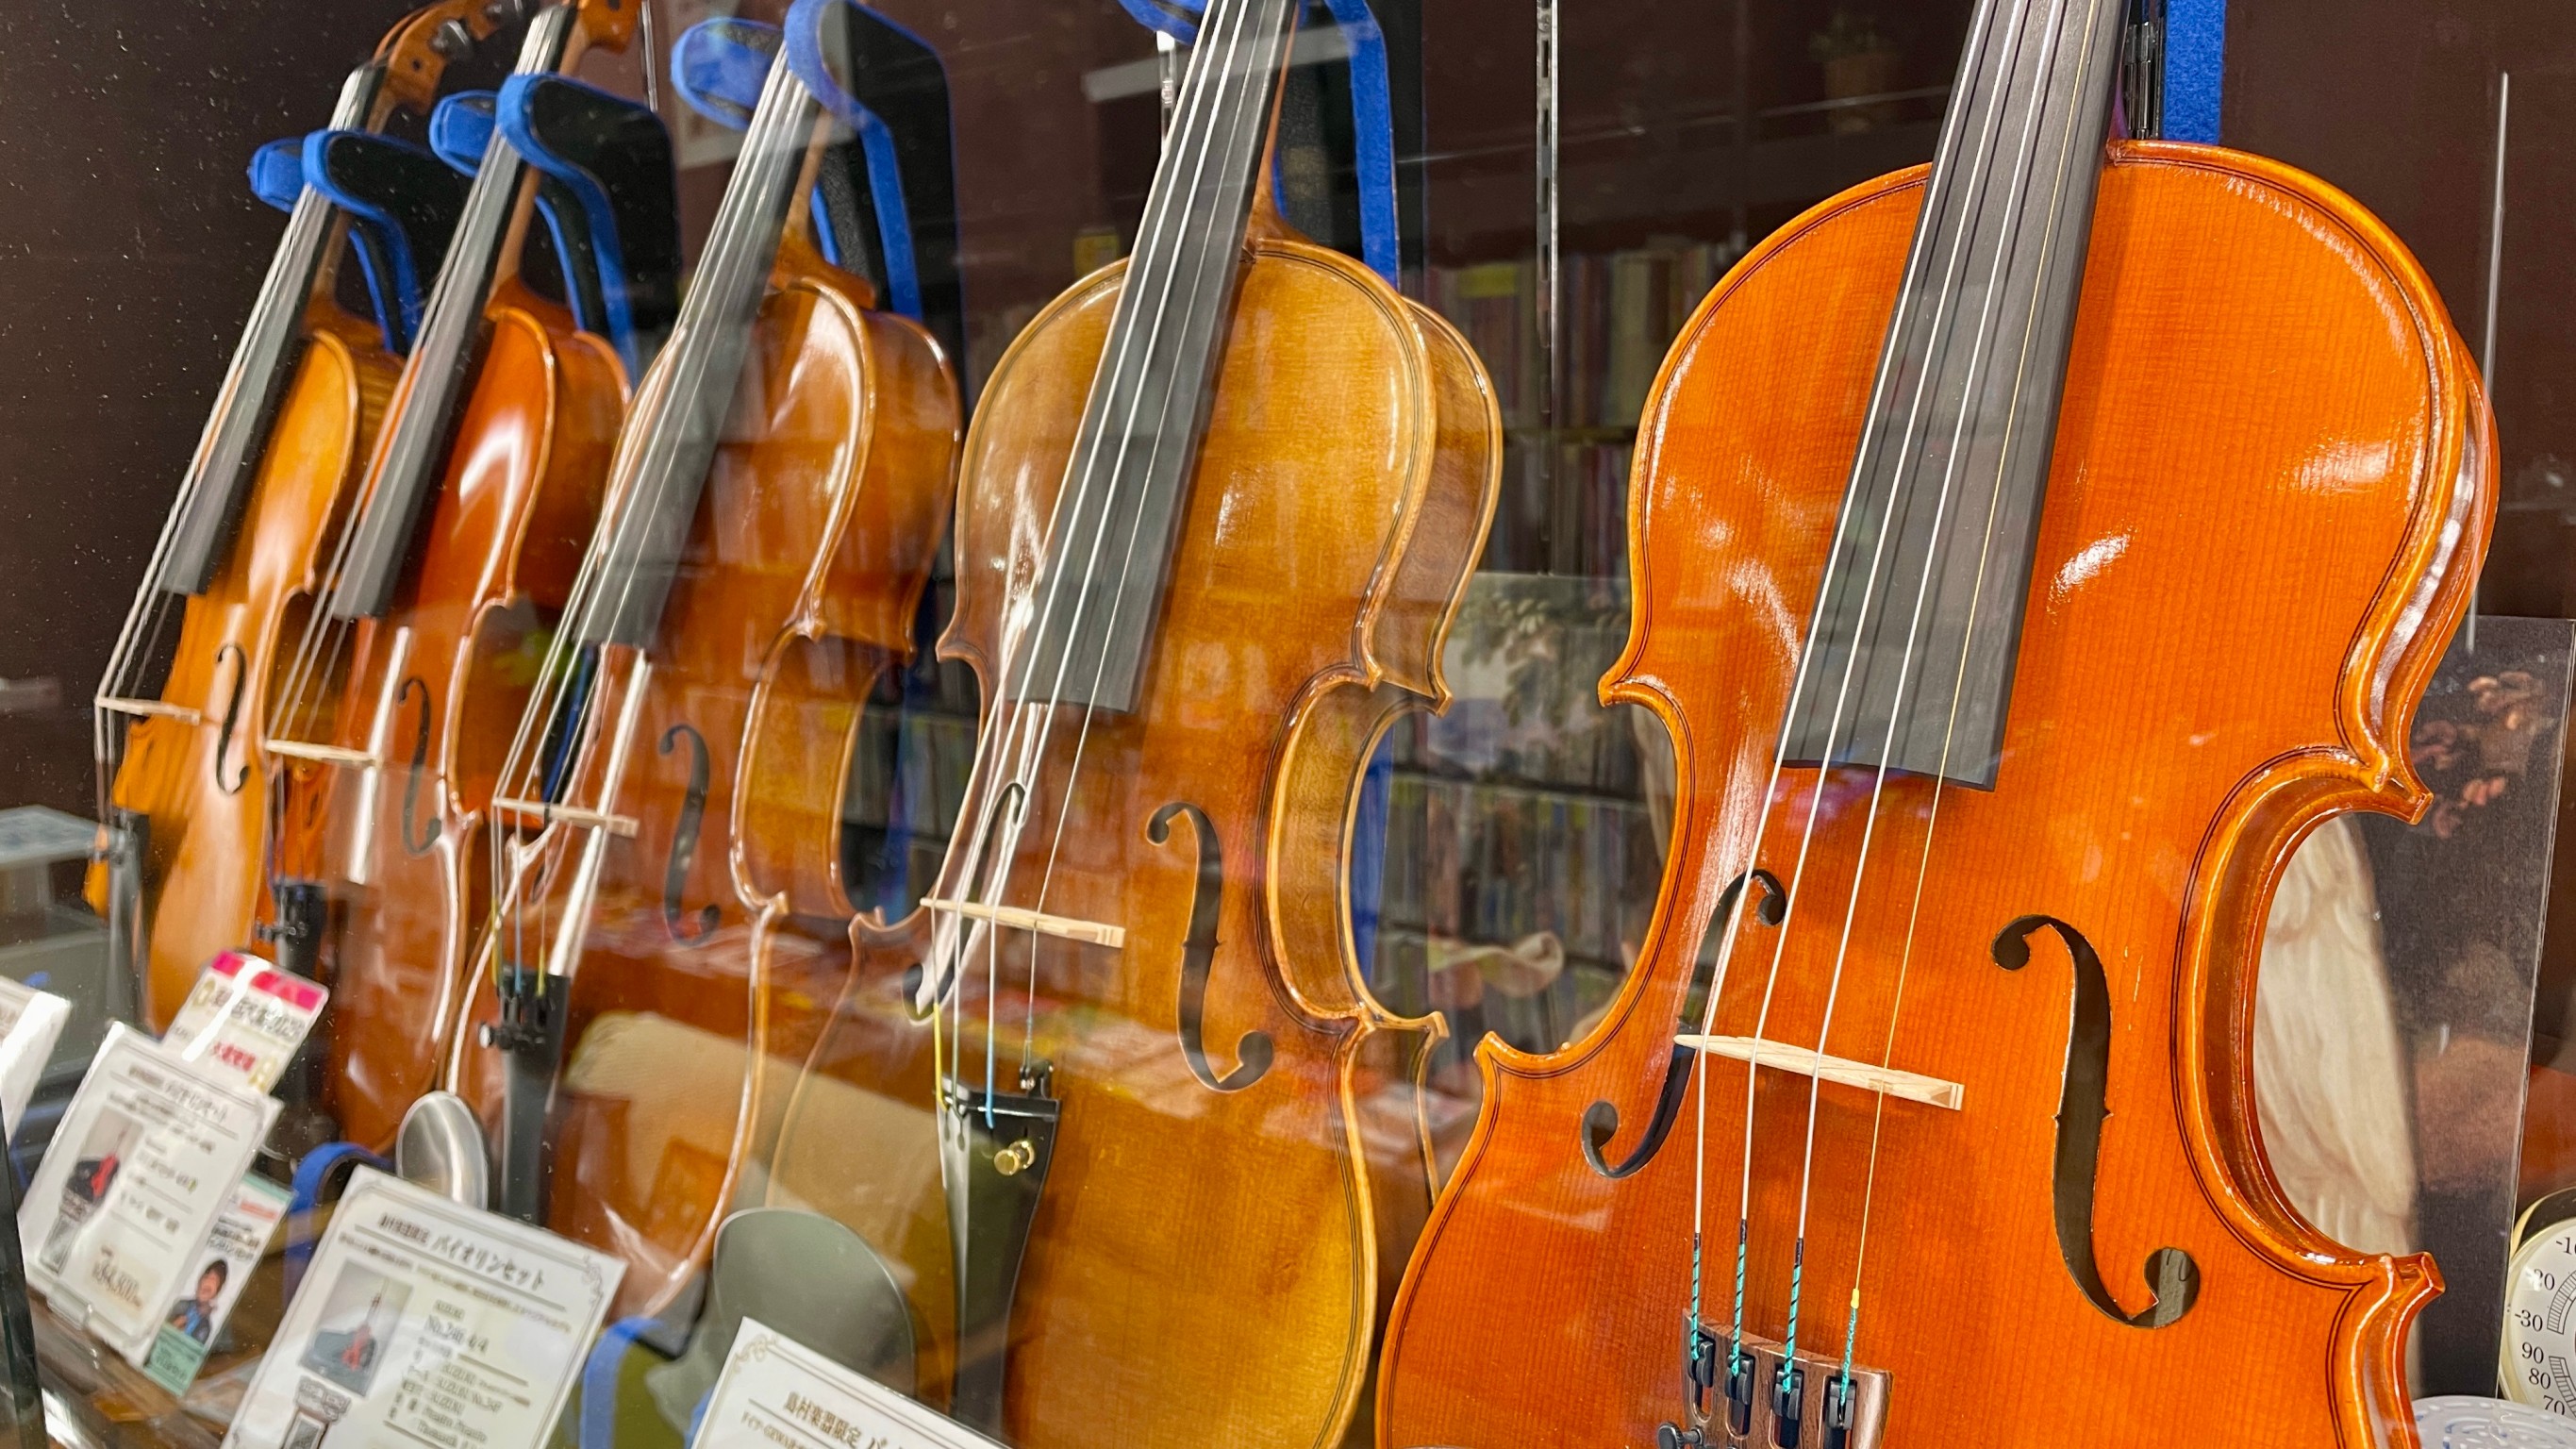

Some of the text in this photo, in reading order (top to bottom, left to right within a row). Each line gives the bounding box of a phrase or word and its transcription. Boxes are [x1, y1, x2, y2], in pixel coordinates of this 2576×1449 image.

[2555, 1237, 2576, 1255] -1
[2515, 1309, 2543, 1332] -30
[2521, 1341, 2544, 1364] 90
[2528, 1367, 2551, 1390] 80
[2543, 1395, 2566, 1415] 70
[784, 1391, 862, 1449] 島村楽器限定
